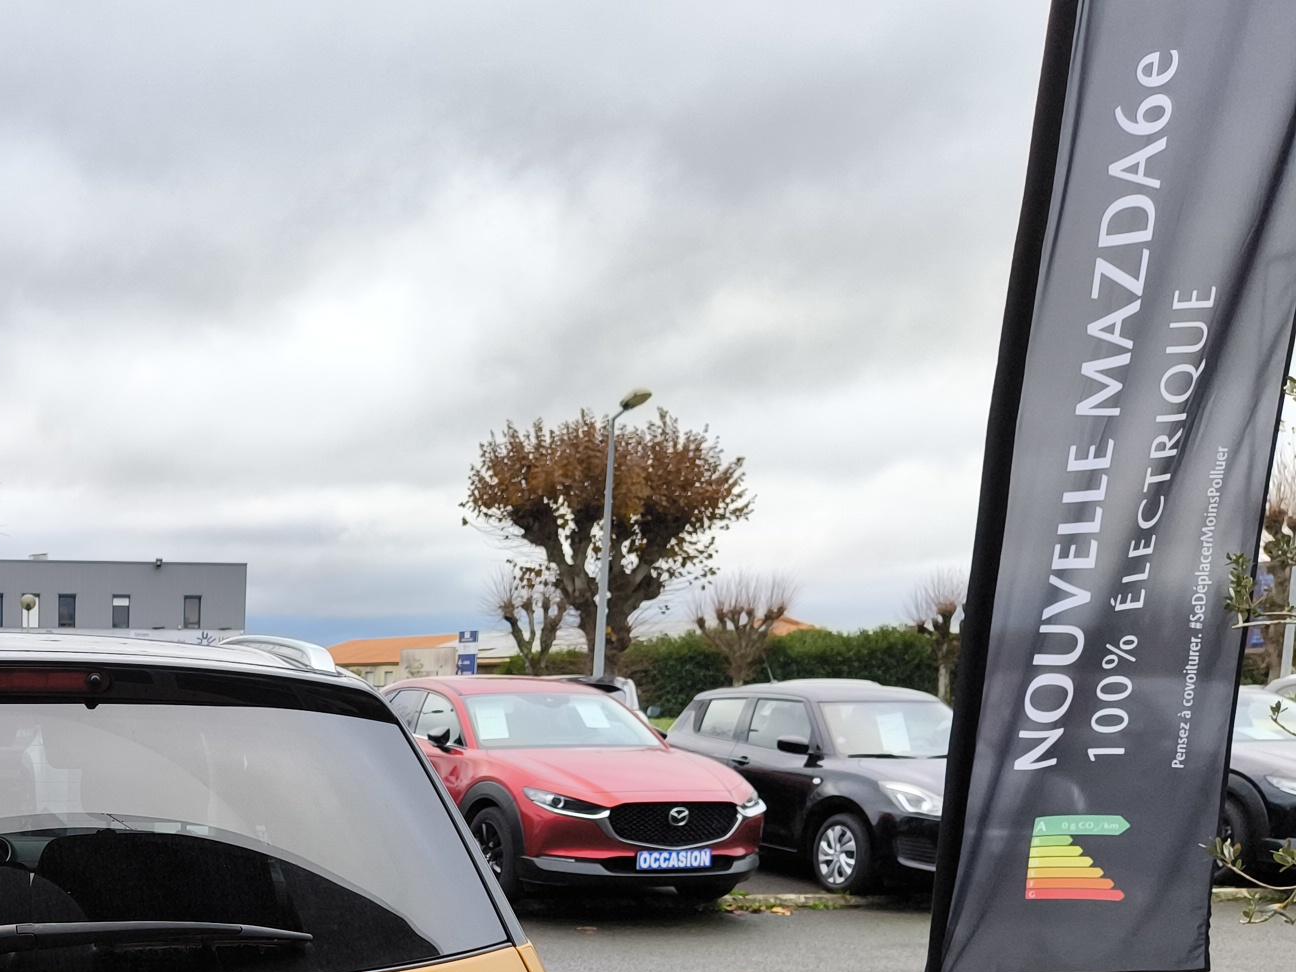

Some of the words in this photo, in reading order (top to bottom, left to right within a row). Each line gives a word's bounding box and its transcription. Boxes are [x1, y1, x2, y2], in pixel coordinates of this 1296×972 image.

[1014, 438, 1115, 770] NOUVELLE
[1075, 49, 1179, 416] MAZDA6e
[1110, 286, 1217, 612] ÉLECTRIQUE
[1189, 445, 1229, 629] #SeDéplacerMoinsPolluer
[1087, 634, 1138, 762] 100%
[1183, 633, 1202, 707] covoiturer.
[1171, 721, 1190, 769] Pensez
[1177, 710, 1192, 719] à
[640, 849, 712, 869] OCCASION
[1035, 821, 1047, 832] A
